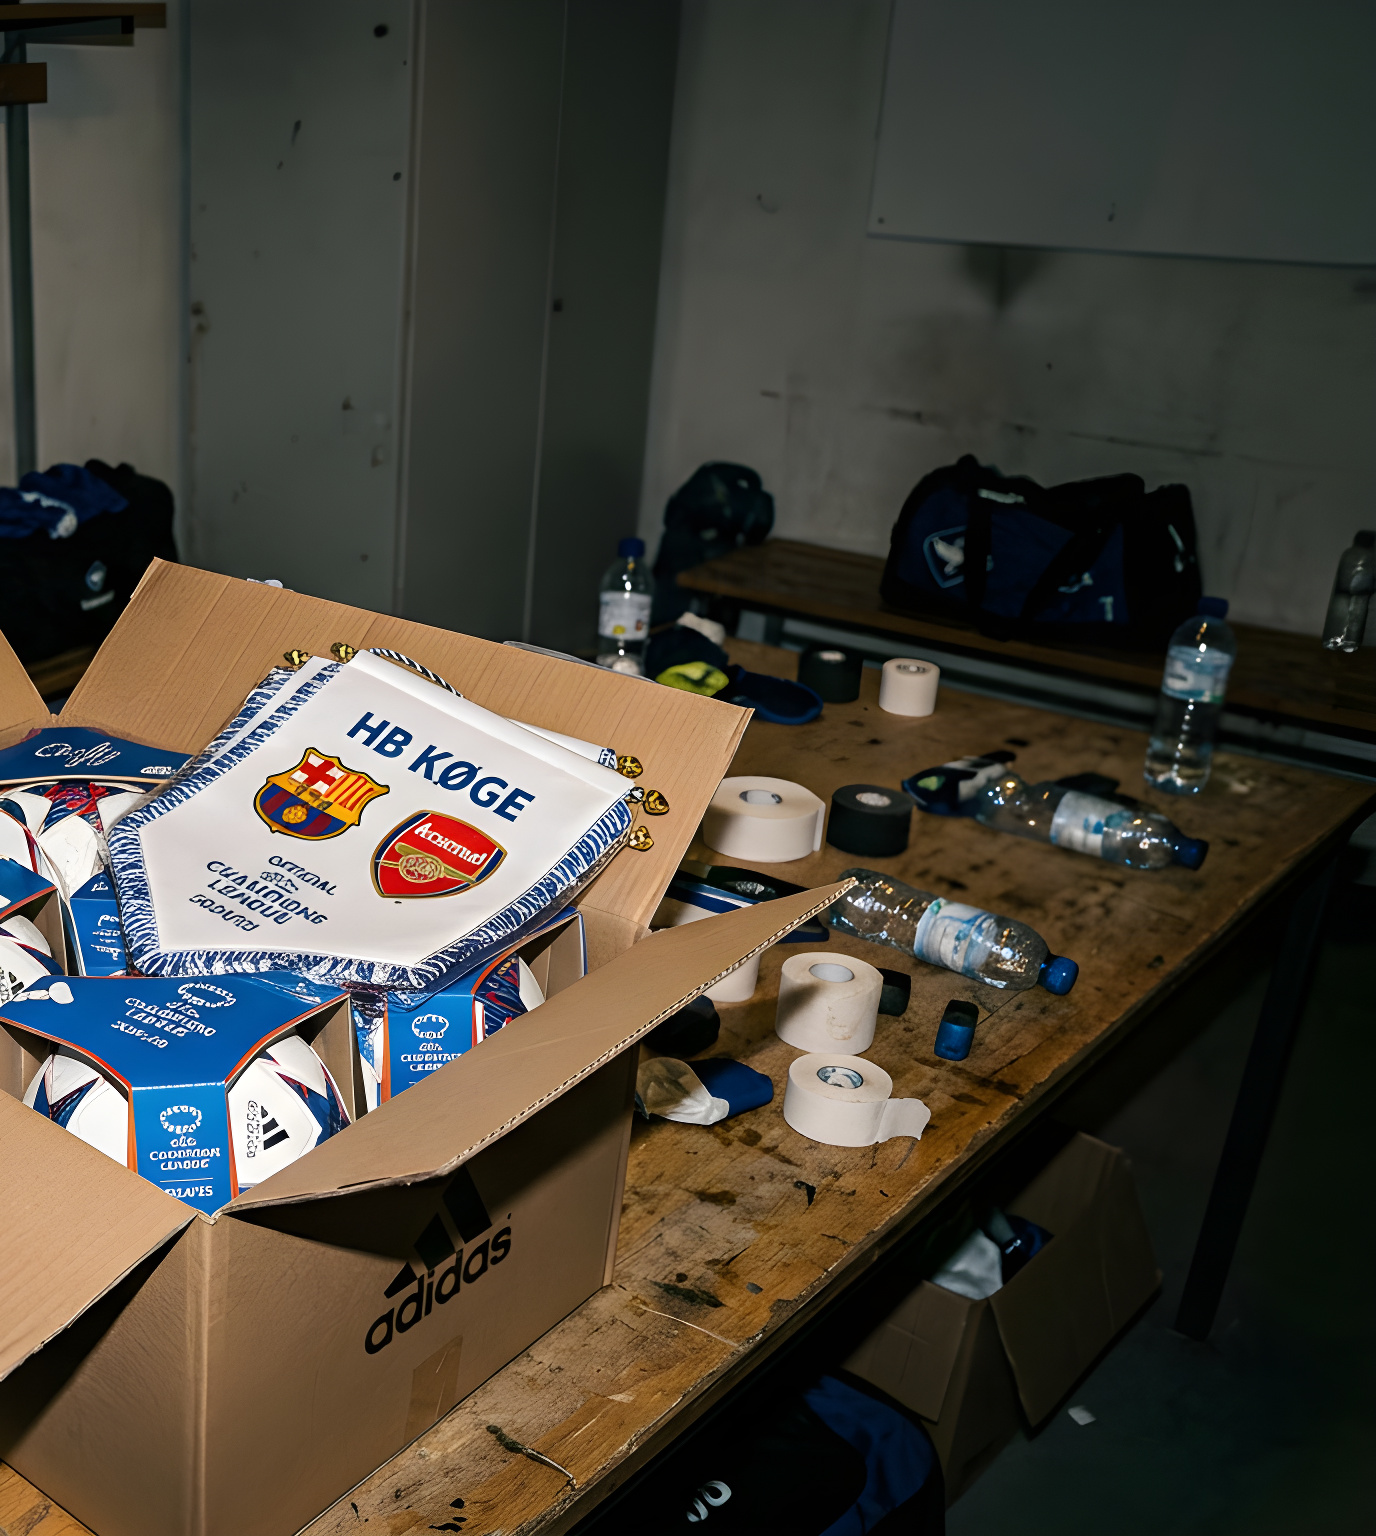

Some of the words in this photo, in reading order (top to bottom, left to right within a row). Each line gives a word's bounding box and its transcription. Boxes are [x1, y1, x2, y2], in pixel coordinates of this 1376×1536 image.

[346, 711, 413, 759] HB
[407, 744, 536, 823] KØGE
[364, 1225, 512, 1355] adidas
